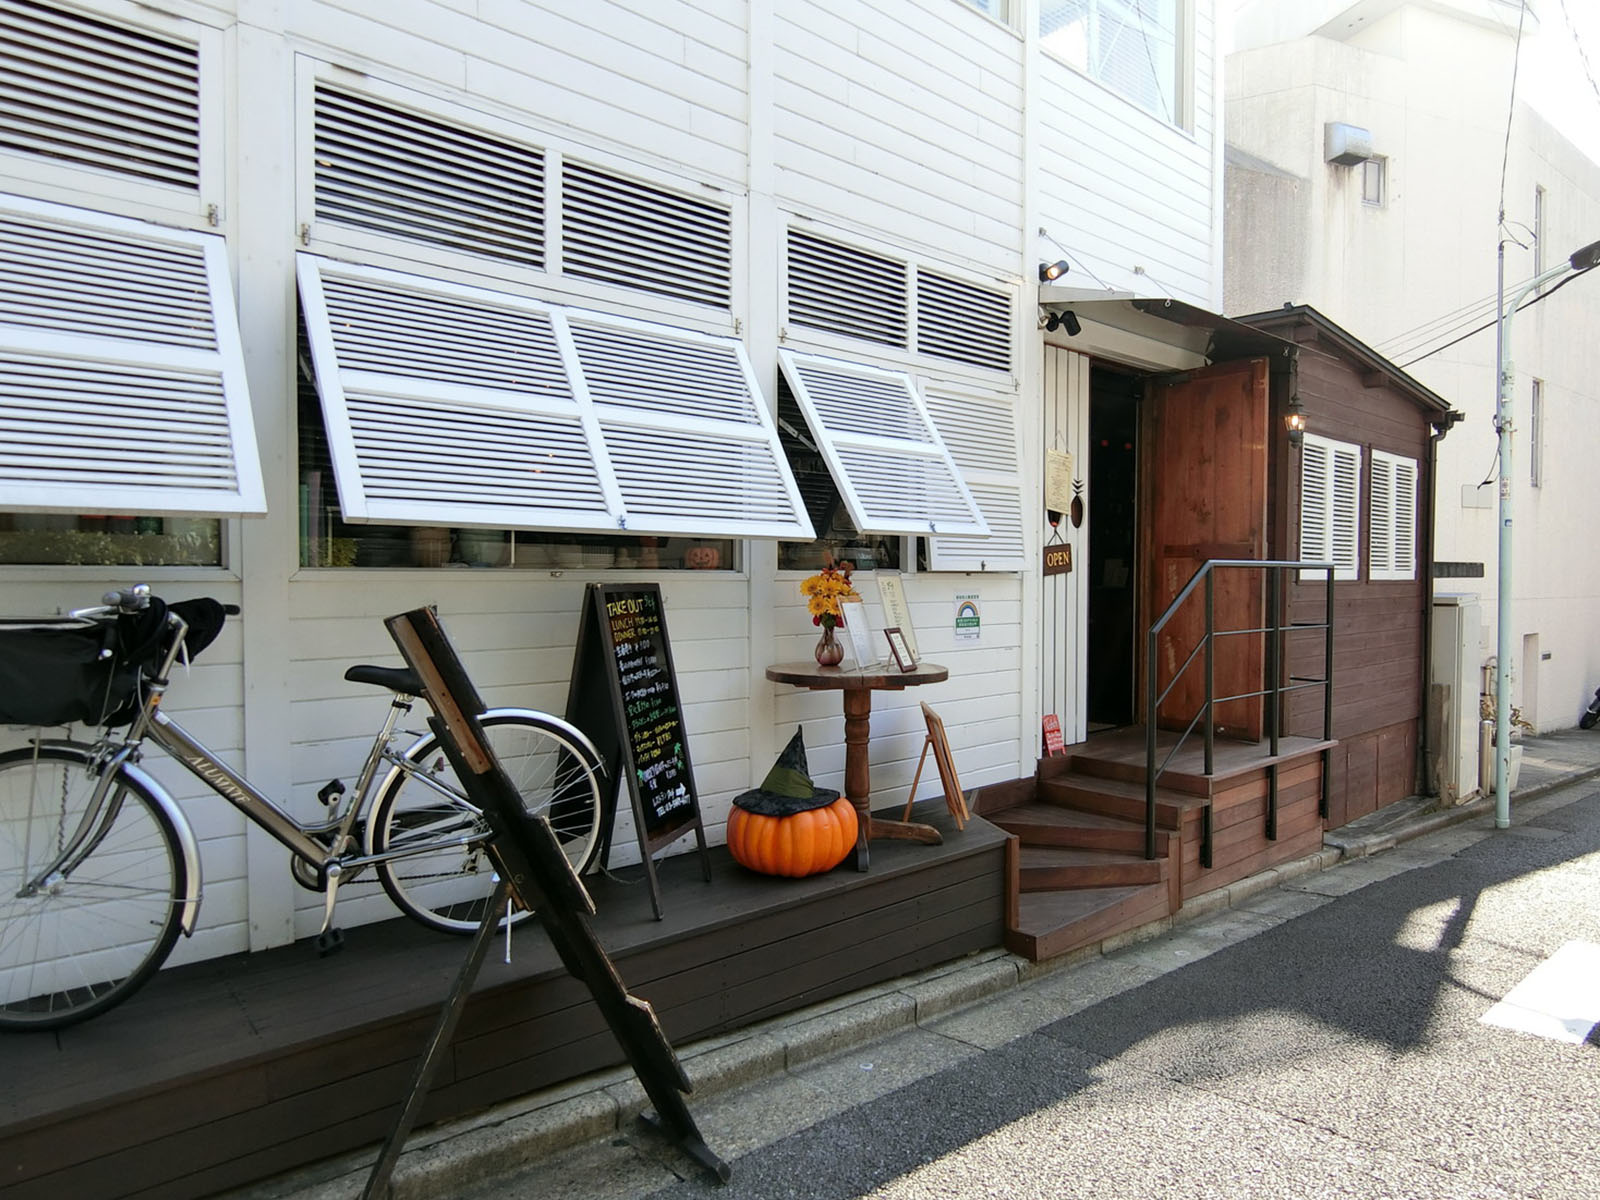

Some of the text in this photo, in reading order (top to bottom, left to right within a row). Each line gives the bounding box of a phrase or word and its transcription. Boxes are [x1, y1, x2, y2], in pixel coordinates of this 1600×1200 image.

[1046, 551, 1070, 567] OPEN
[606, 600, 628, 617] TAKE
[627, 599, 644, 614] OUT
[611, 617, 634, 631] LUNCH
